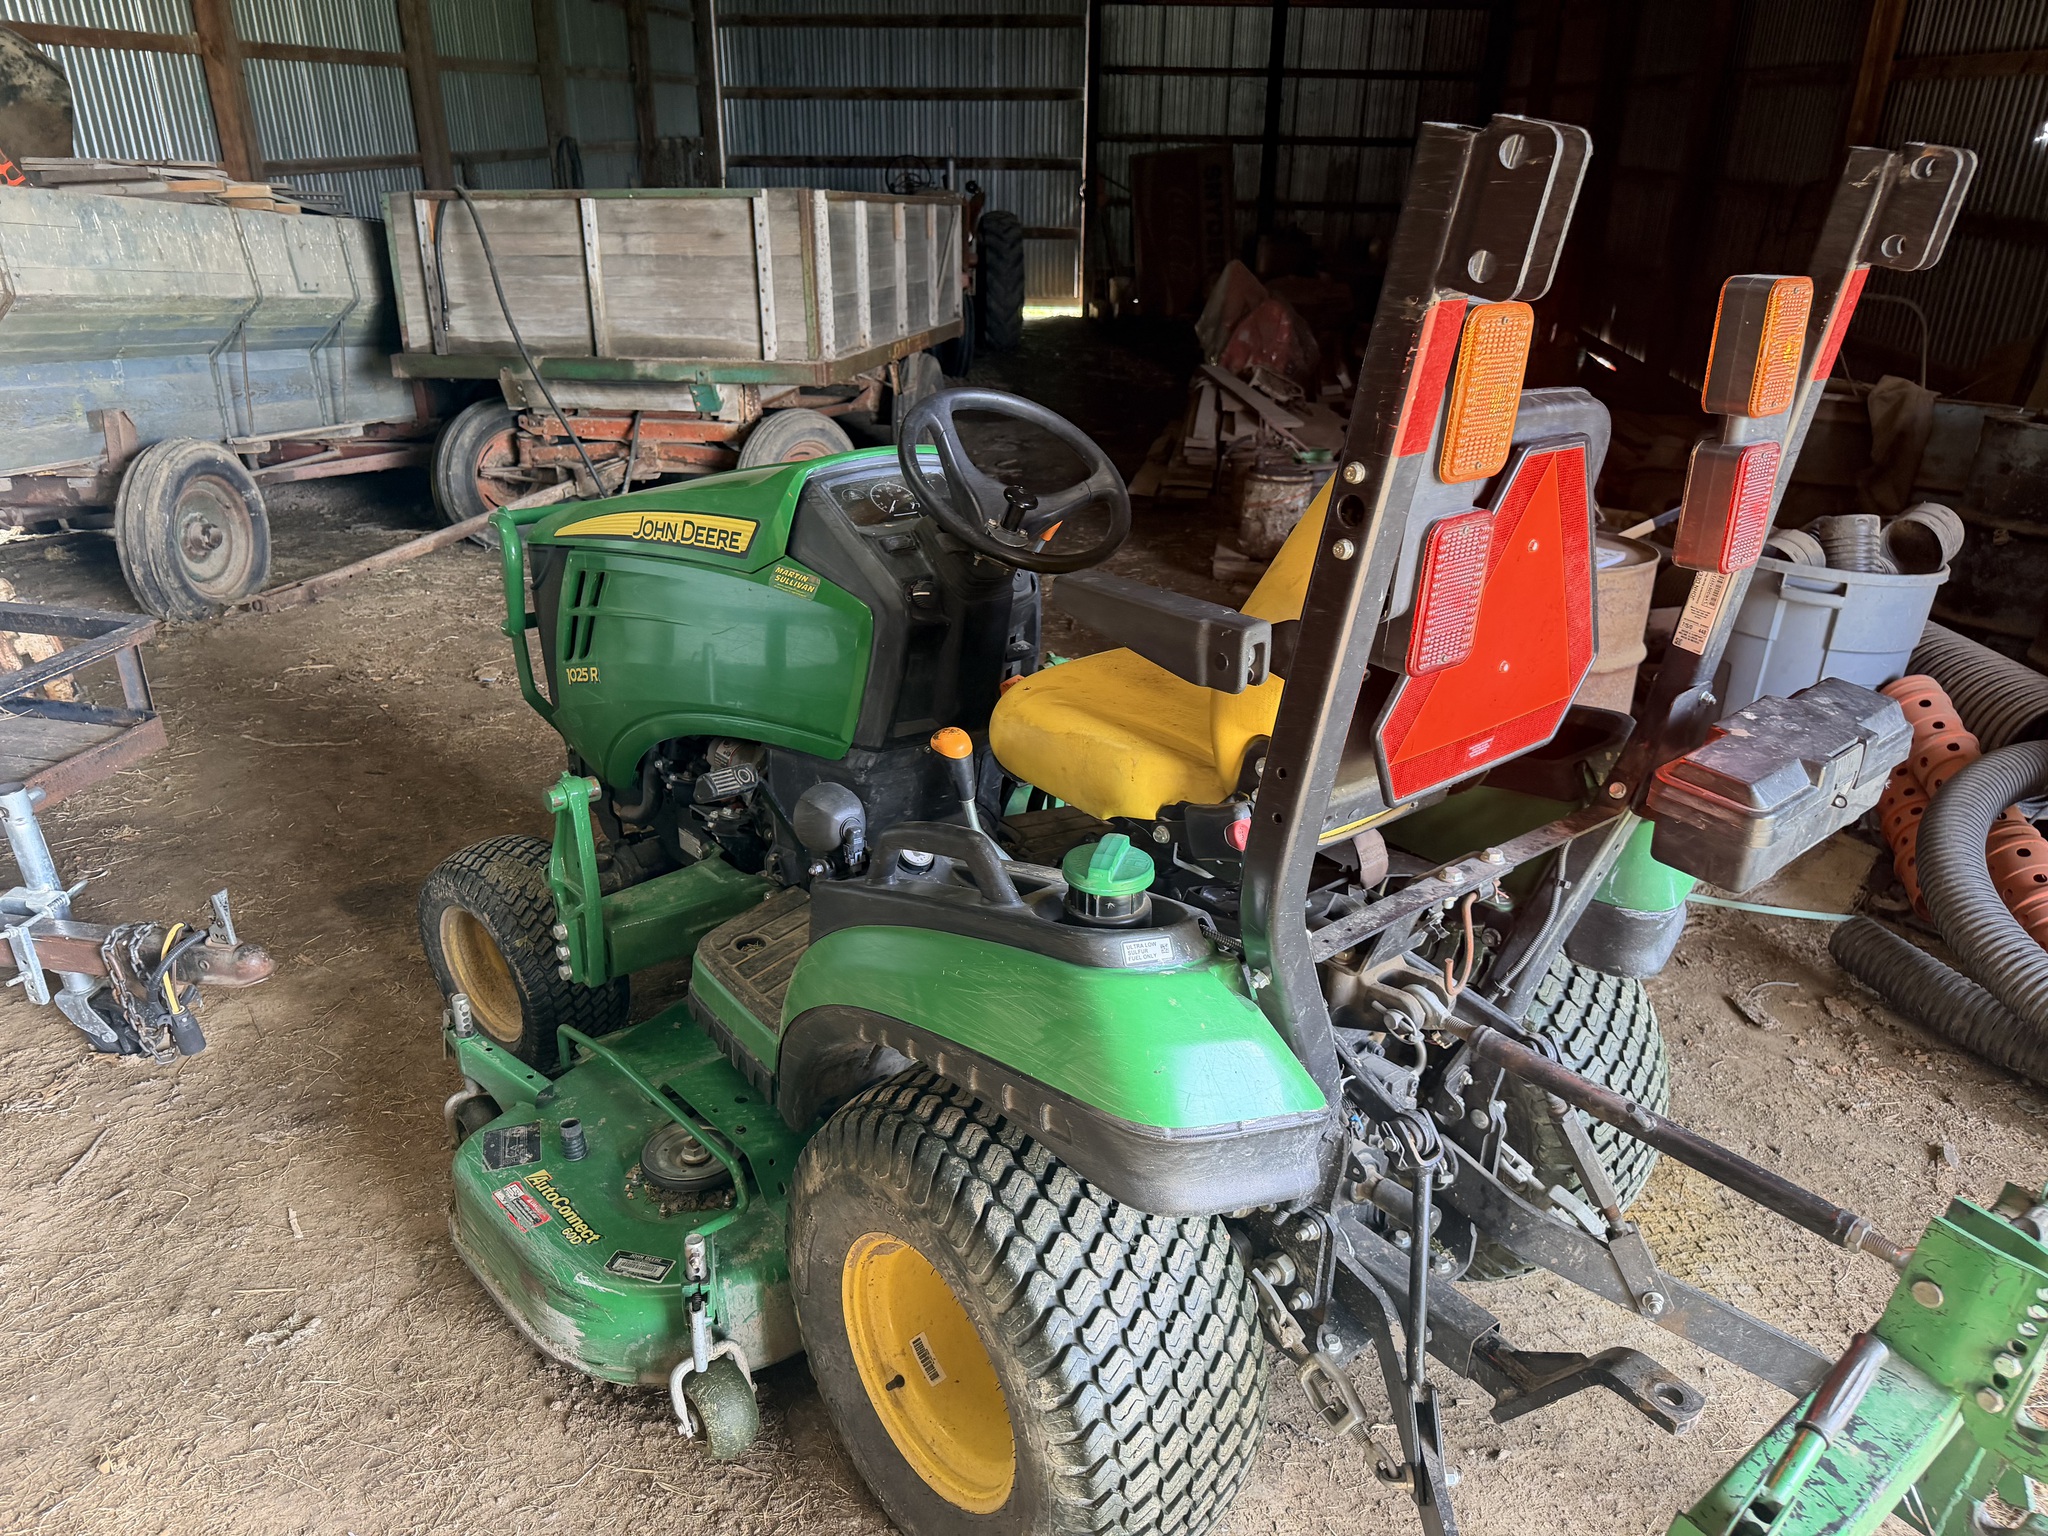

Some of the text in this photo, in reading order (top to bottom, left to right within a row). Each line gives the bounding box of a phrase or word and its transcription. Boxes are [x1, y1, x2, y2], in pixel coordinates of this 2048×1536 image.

[633, 516, 742, 551] JOHN DEERE
[775, 567, 809, 582] MARTIN
[775, 575, 815, 593] SULLIVAN
[531, 1175, 601, 1245] AutoConnect
[561, 1227, 582, 1245] 60D
